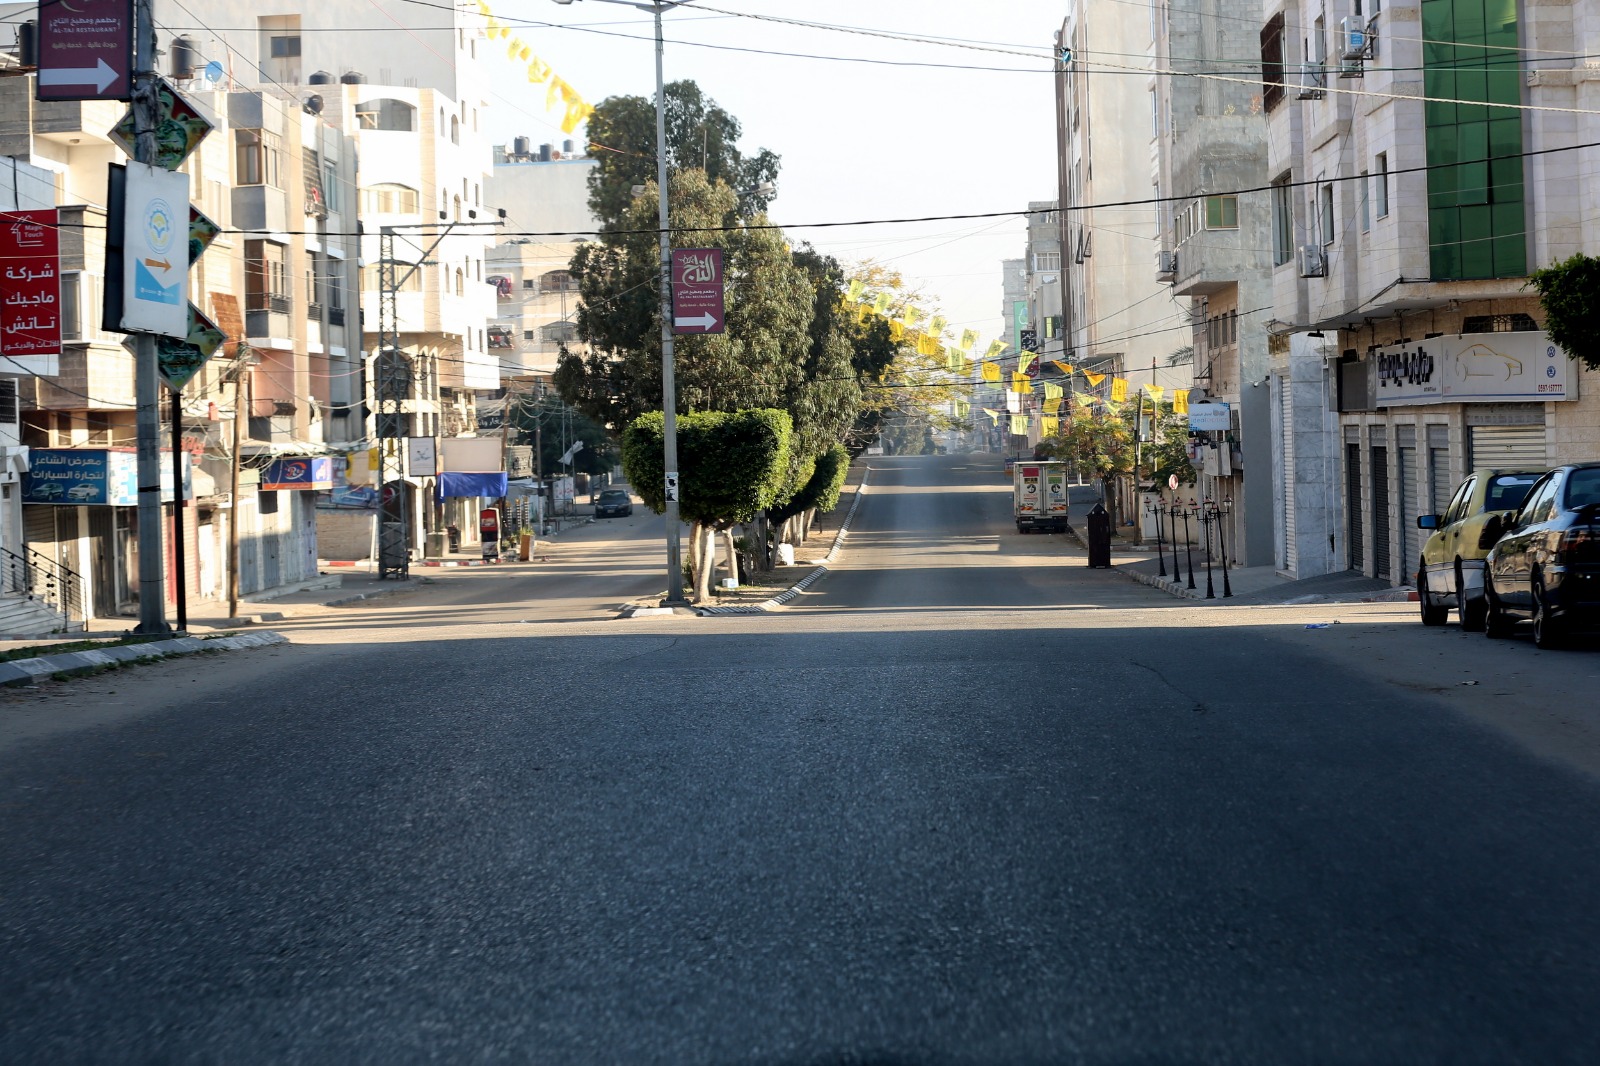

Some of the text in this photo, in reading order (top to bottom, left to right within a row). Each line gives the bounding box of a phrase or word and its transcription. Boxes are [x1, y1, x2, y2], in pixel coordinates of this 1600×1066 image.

[70, 17, 94, 26] ومطبخ
[5, 263, 54, 282] شركة
[5, 290, 55, 308] ماجيك
[5, 315, 56, 334] تاتش
[35, 456, 102, 467] معرض الشاعر
[32, 470, 105, 481] لتجارة السيارات
